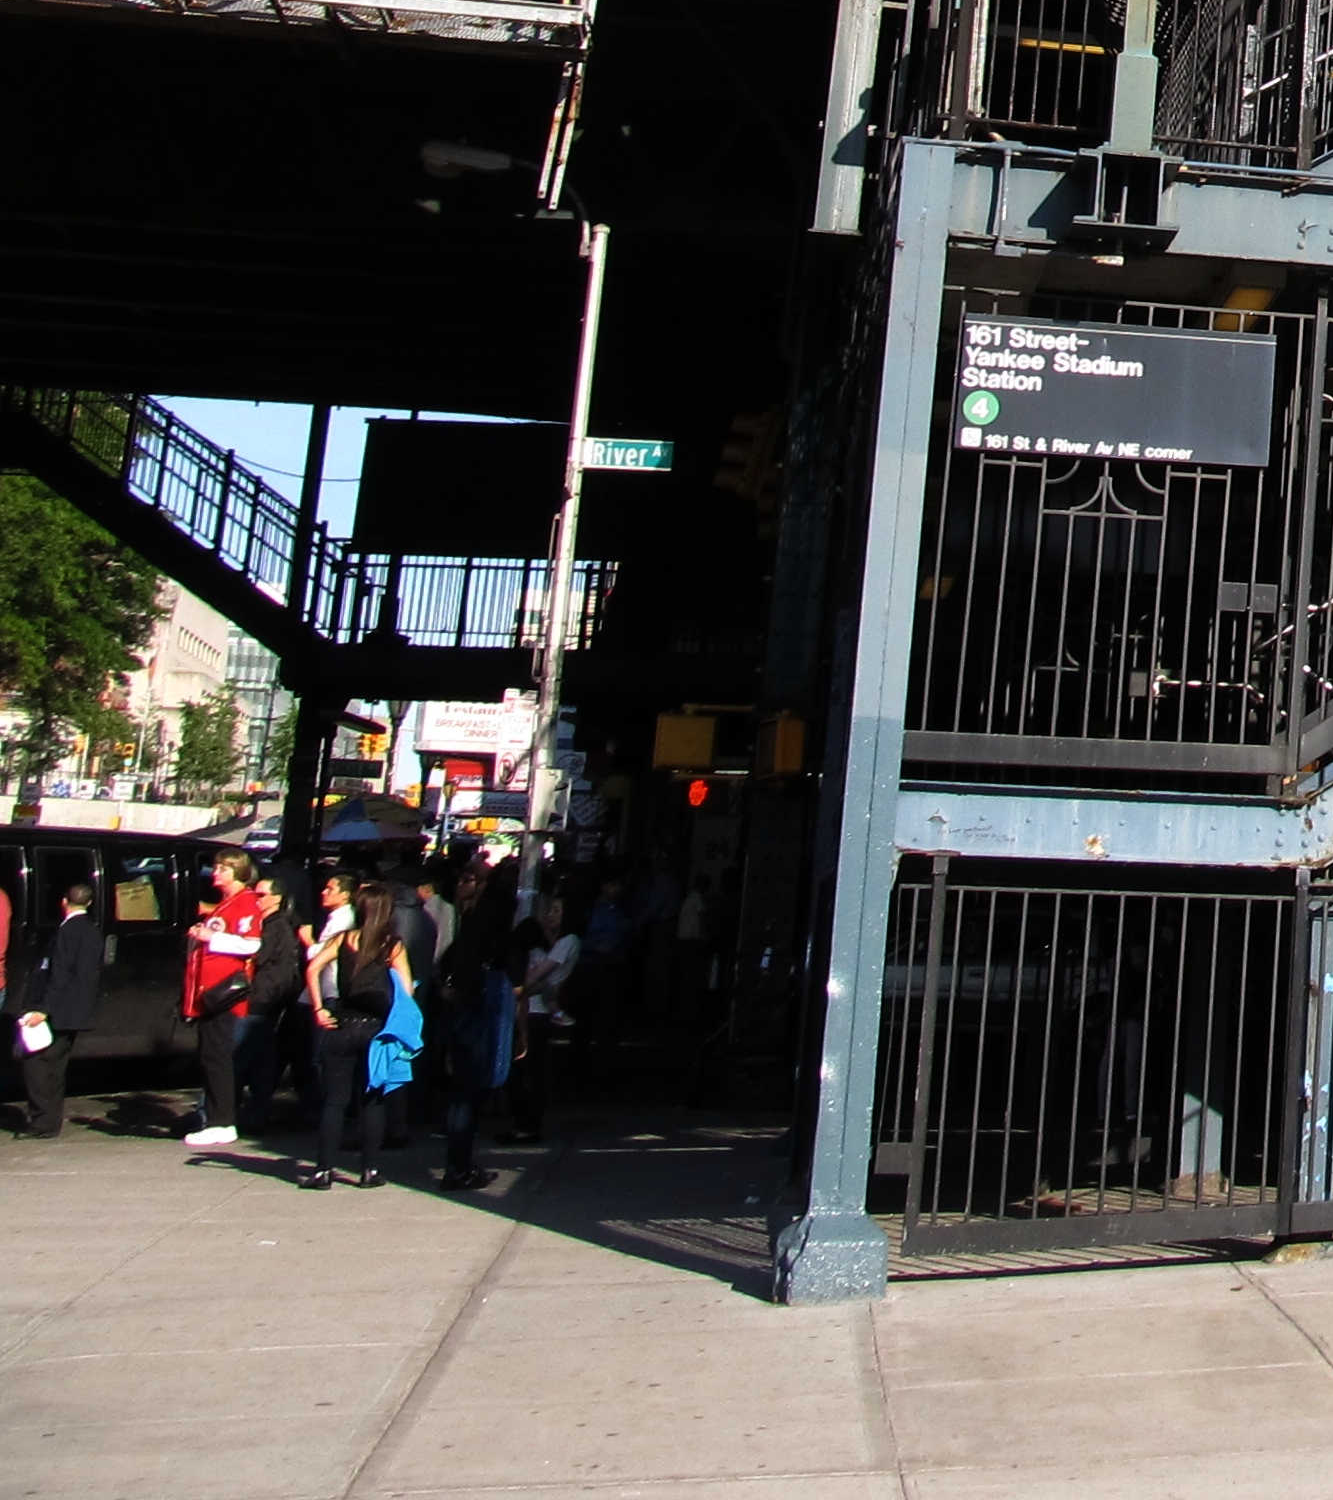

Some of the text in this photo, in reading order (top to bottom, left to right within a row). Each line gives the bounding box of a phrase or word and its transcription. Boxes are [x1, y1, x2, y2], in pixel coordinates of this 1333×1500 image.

[965, 325, 1090, 352] 161 Street-
[965, 346, 1143, 378] Yankee Stadium
[961, 367, 1042, 392] Station
[970, 397, 990, 419] 4
[592, 442, 648, 467] River
[984, 434, 1193, 461] 161 St & River Av NE corner
